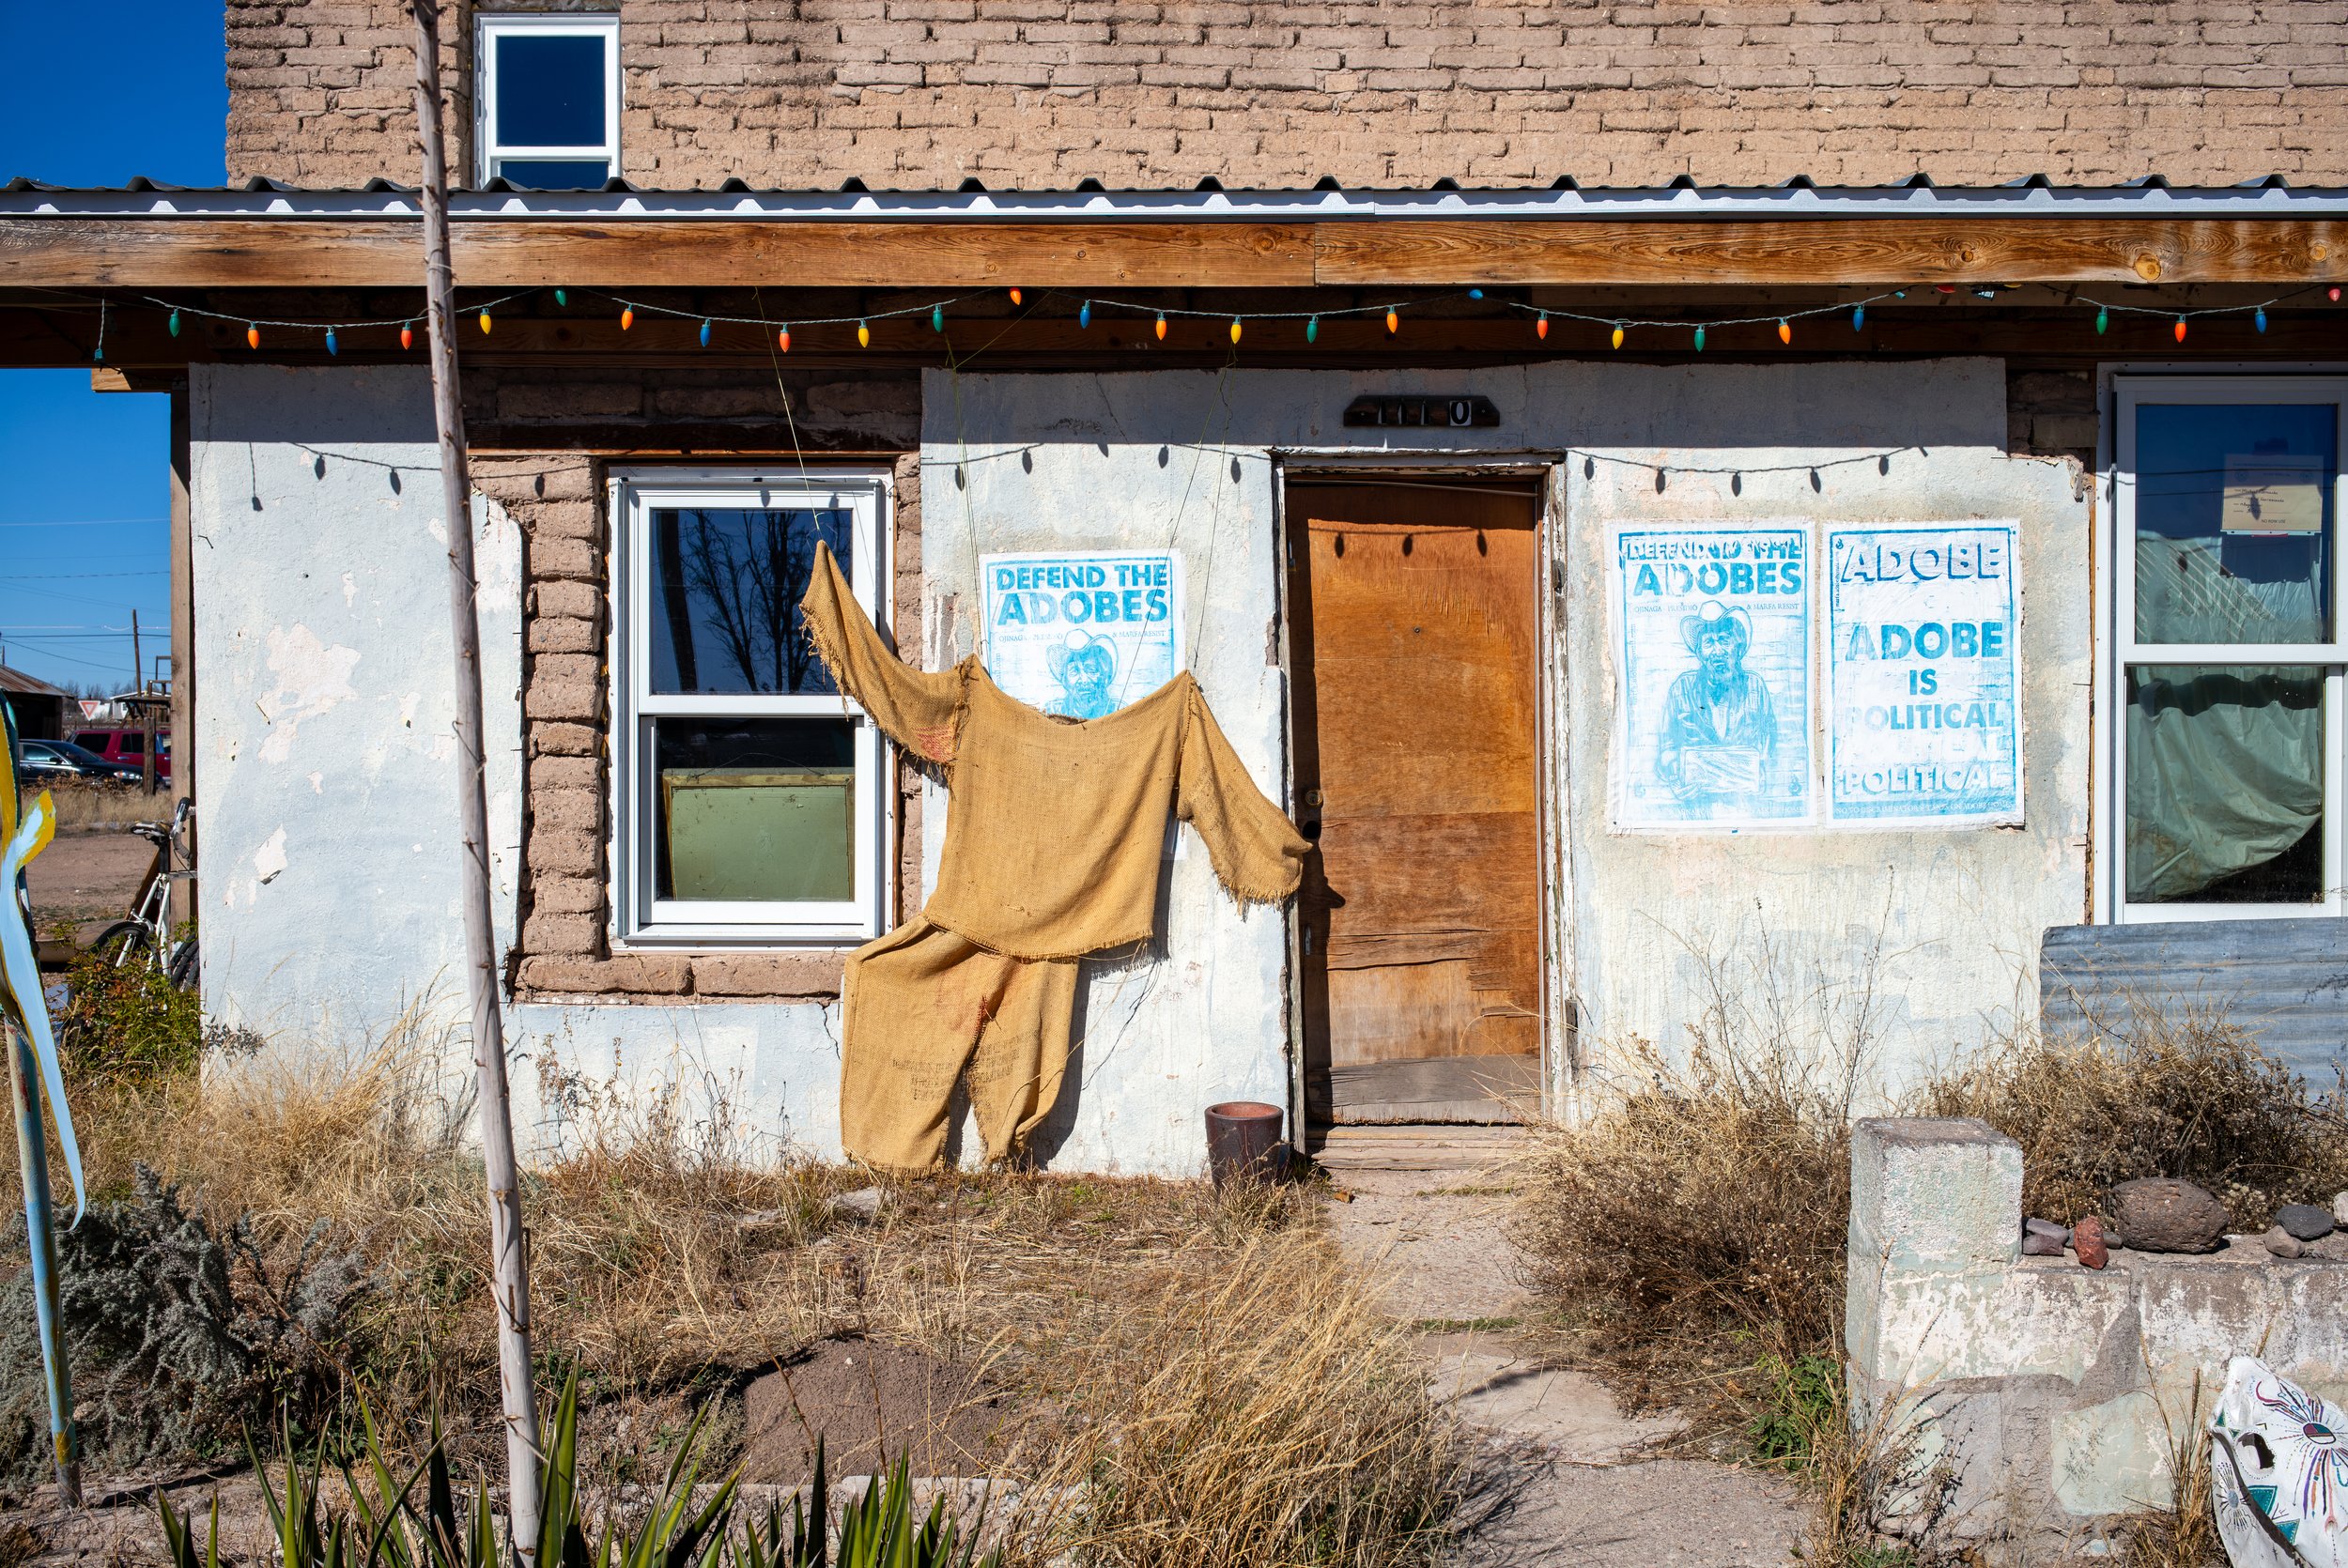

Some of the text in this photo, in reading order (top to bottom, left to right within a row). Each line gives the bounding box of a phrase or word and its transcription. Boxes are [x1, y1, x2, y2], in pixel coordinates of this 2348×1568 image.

[996, 563, 1167, 591] DEFEND THE
[1633, 561, 1802, 596] ADOBES
[1841, 543, 2000, 583] ADOBE
[997, 589, 1167, 626] ADOBES
[1845, 621, 2003, 661] ADOBE
[1909, 669, 1938, 696] IS
[1845, 702, 2004, 730] POLITICAL
